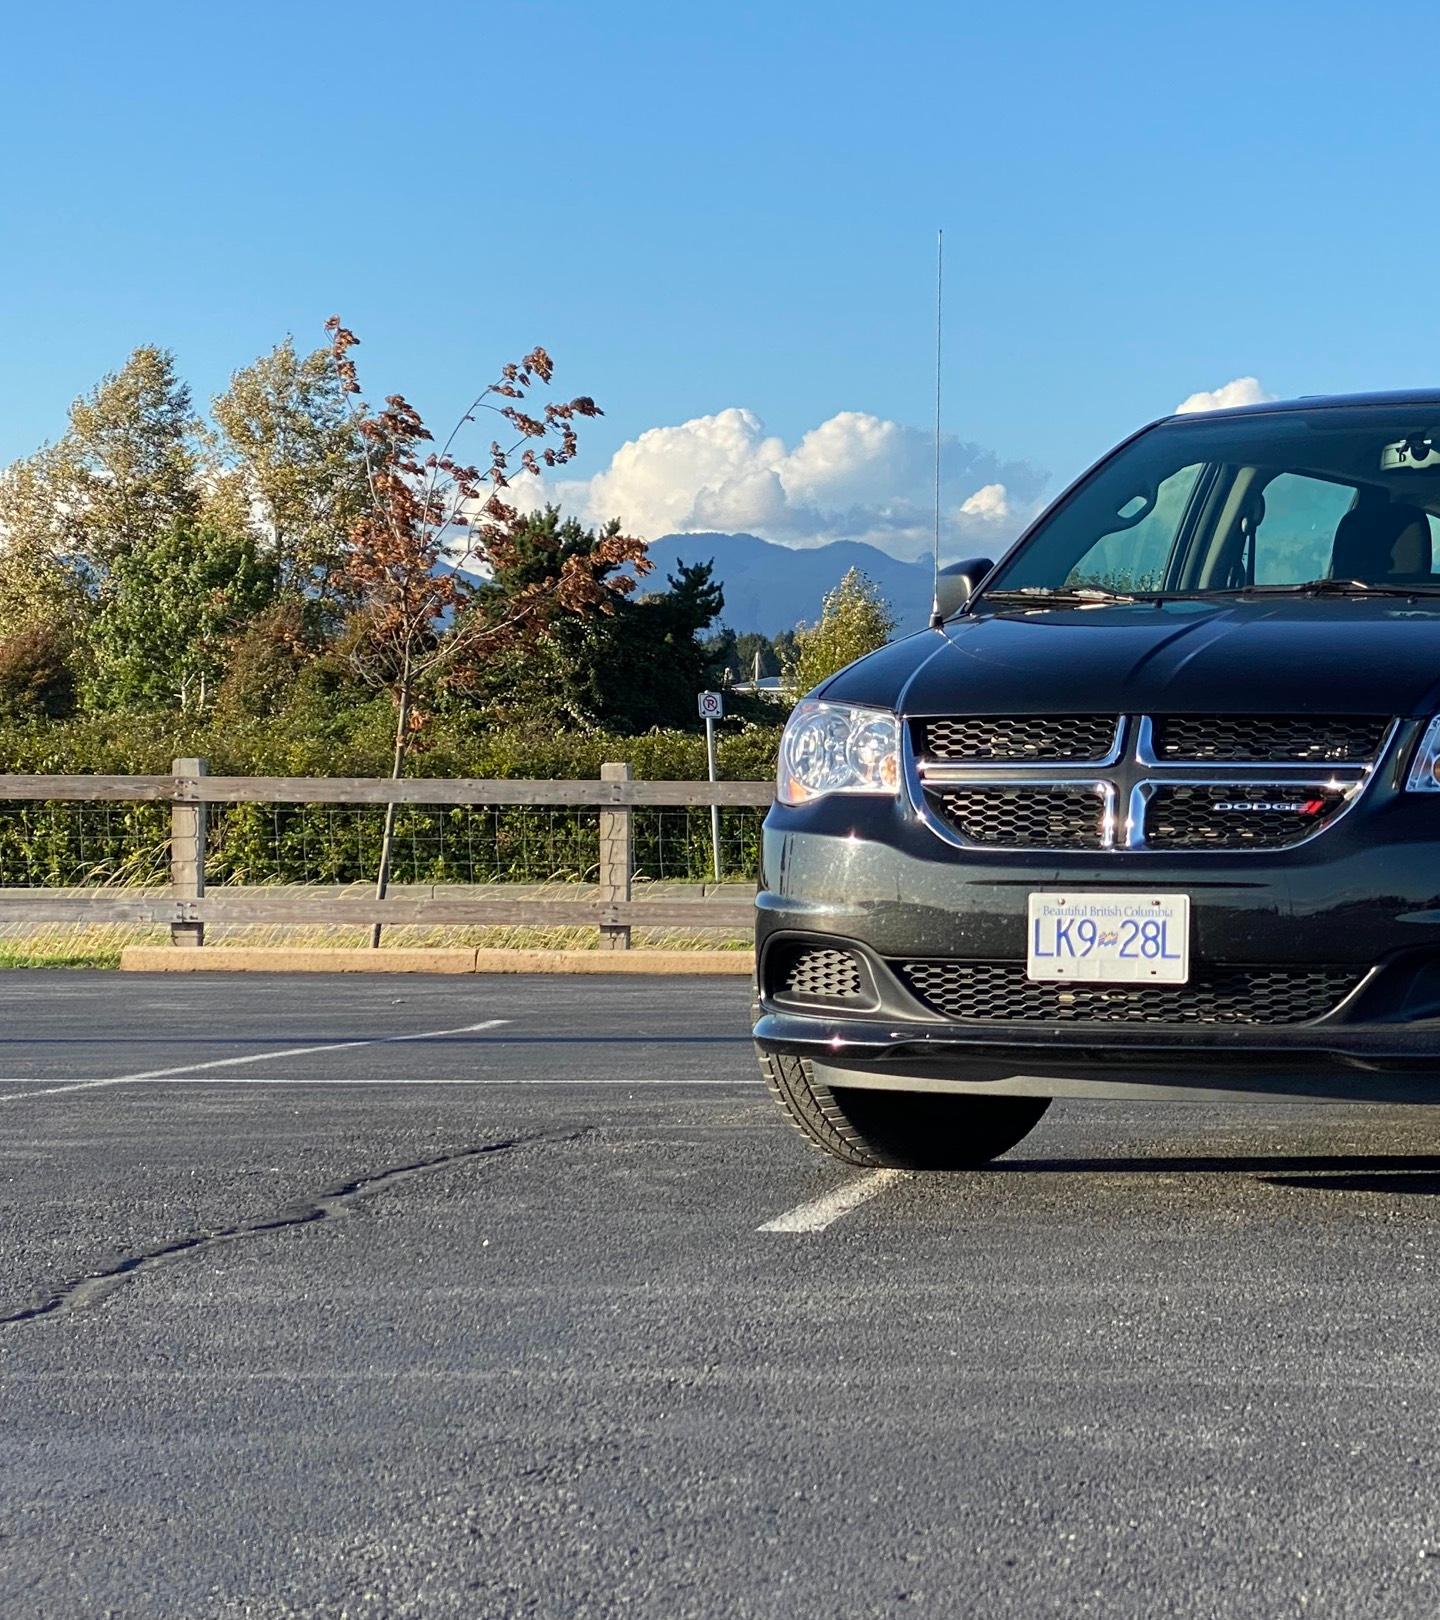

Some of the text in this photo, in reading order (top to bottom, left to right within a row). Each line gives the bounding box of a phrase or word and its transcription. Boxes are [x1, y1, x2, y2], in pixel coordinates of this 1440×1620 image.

[1214, 803, 1309, 811] DODGE
[1043, 906, 1172, 917] Beautiful British Columbia
[1034, 918, 1181, 959] LK9 28L
